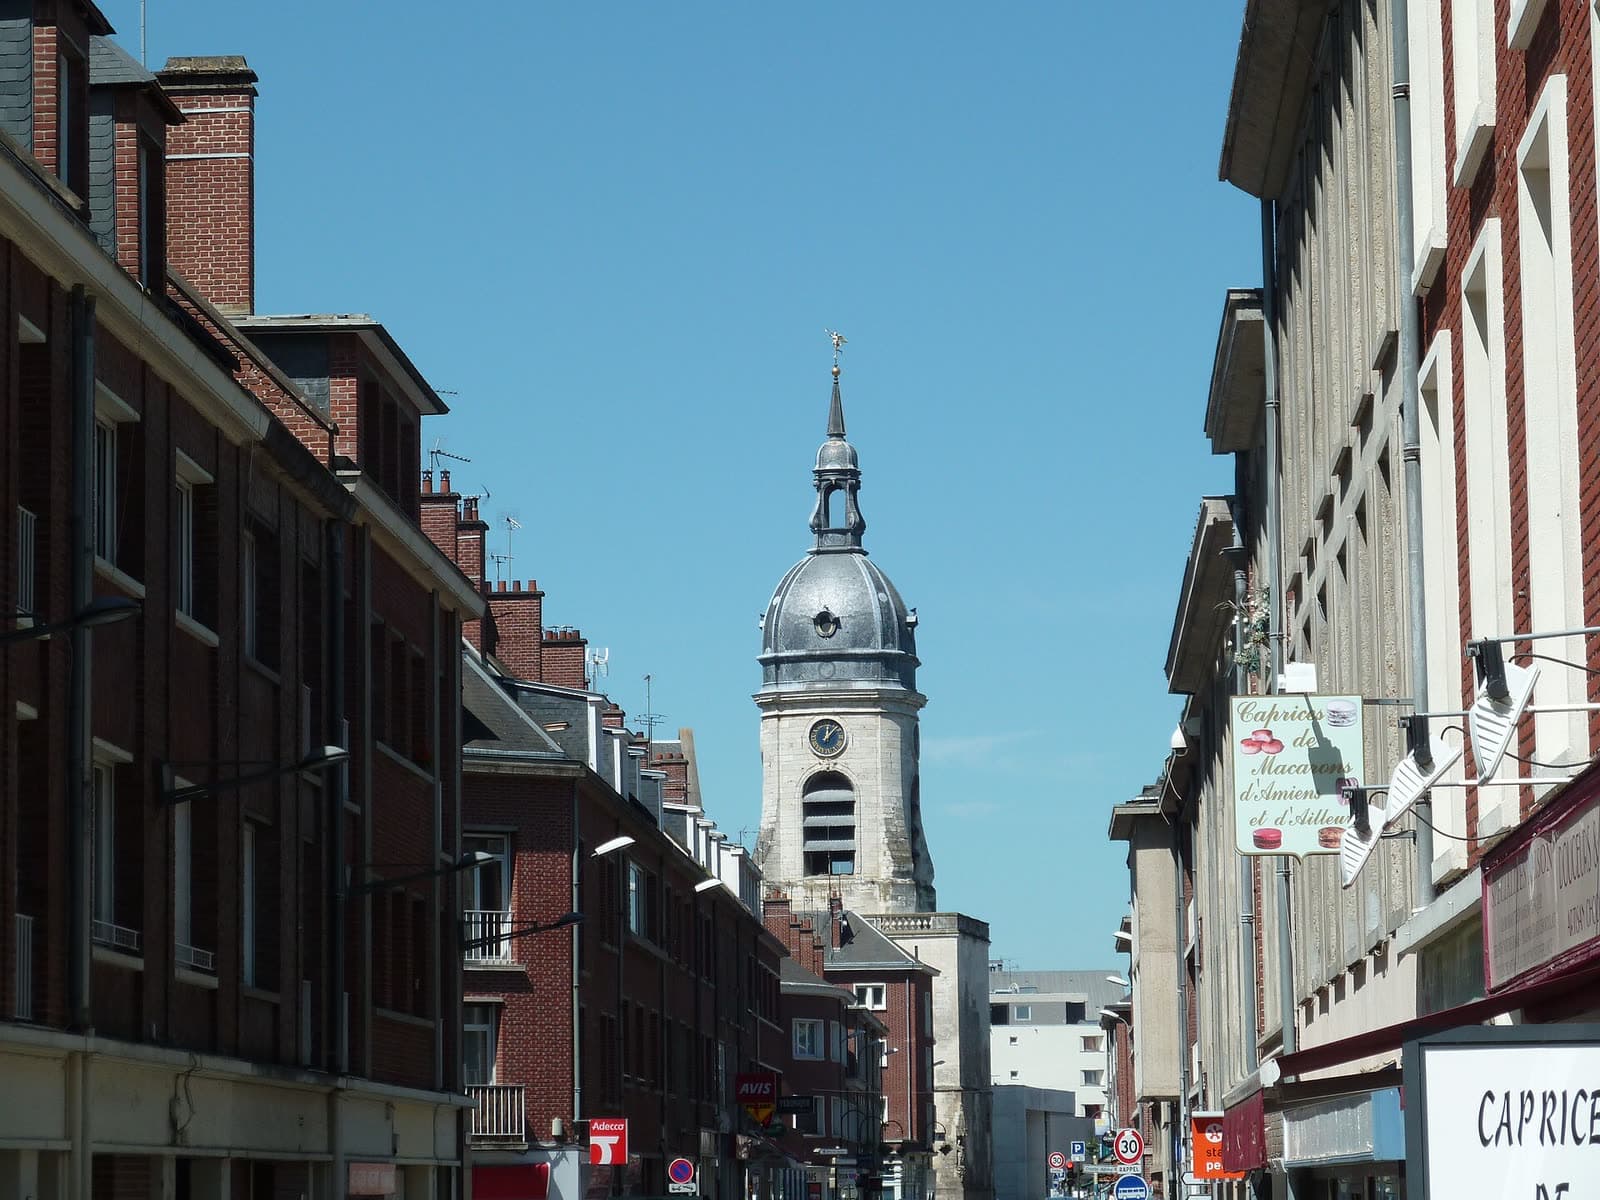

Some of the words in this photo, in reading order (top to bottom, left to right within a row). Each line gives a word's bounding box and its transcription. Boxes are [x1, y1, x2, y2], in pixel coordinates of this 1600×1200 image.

[1237, 701, 1325, 728] Caprices
[1293, 729, 1317, 747] de
[1252, 756, 1354, 775] Macarons
[1240, 778, 1320, 801] d'Amiens
[1249, 811, 1266, 826] et
[740, 1083, 772, 1095] AVIS
[592, 1122, 624, 1131] Adecco
[1074, 1144, 1082, 1152] P
[1121, 1140, 1138, 1153] 30
